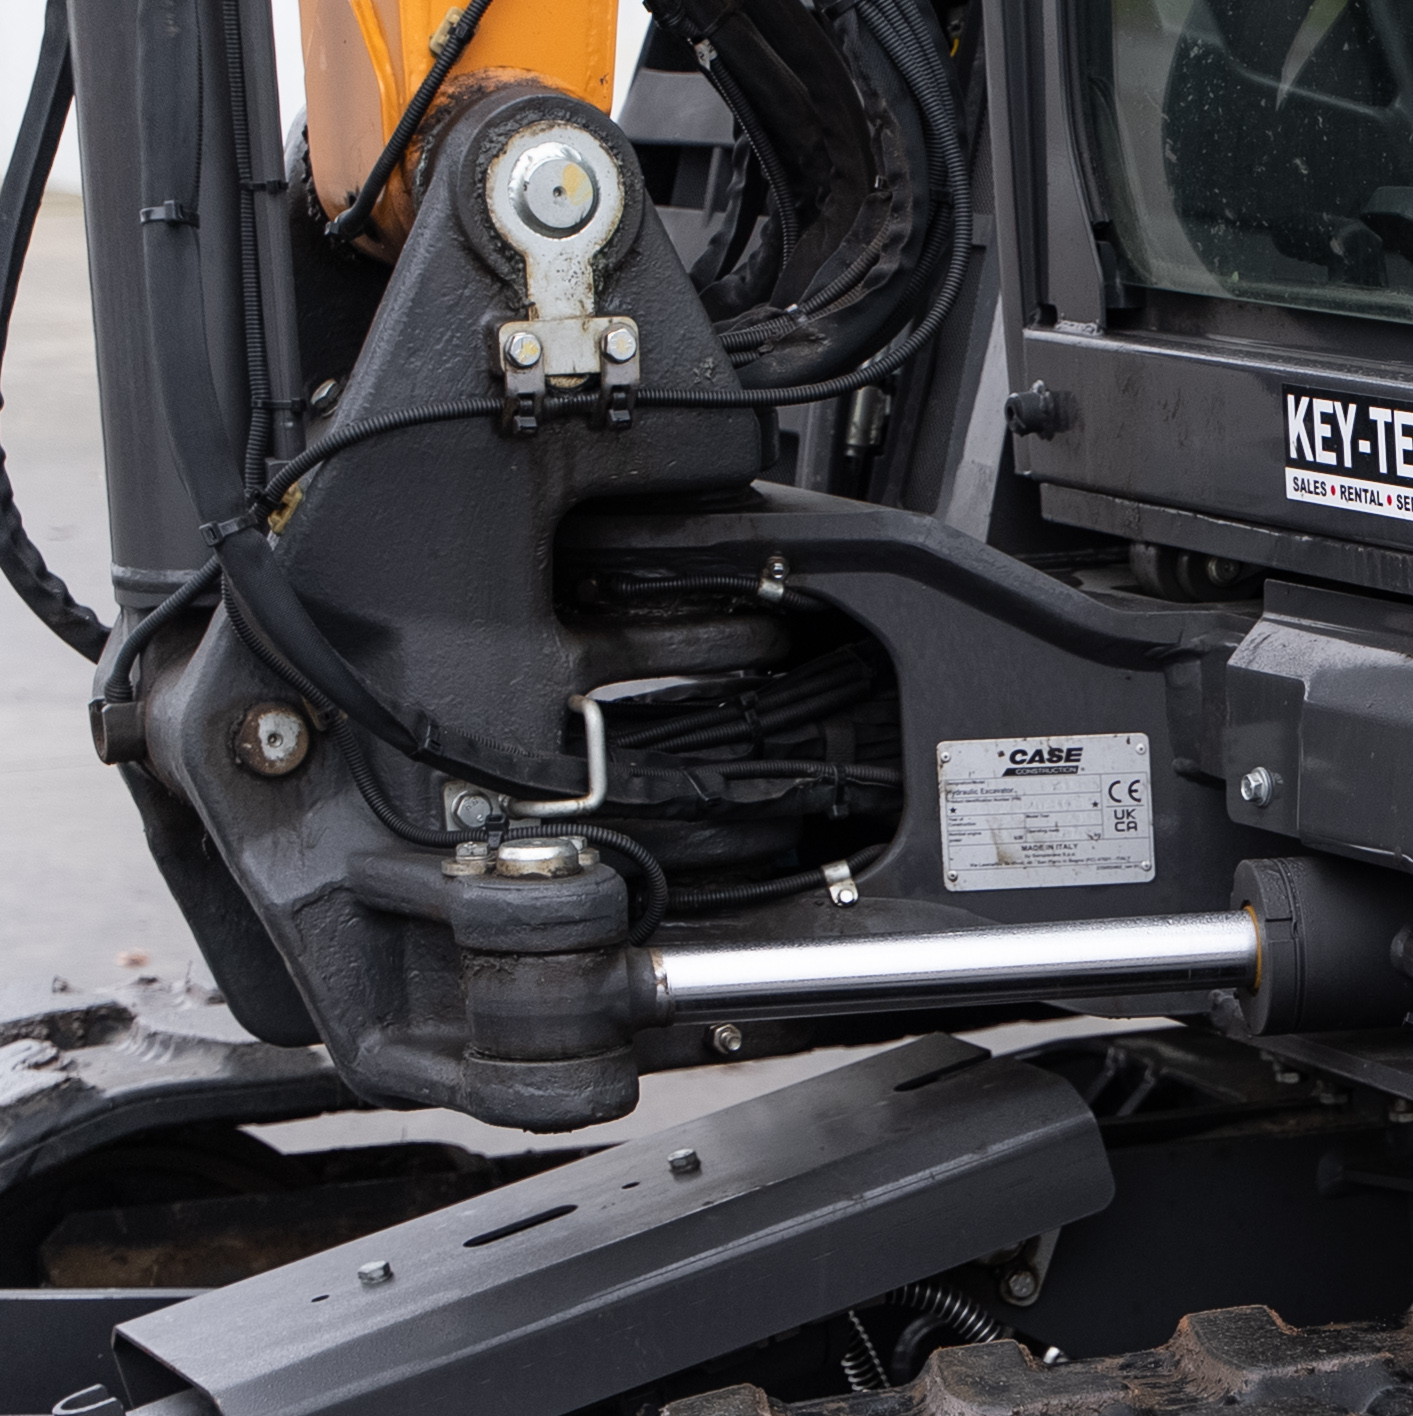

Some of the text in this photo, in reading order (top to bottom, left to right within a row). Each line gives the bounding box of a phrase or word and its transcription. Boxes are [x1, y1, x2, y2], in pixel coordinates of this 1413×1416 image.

[1292, 476, 1327, 497] SALES
[1339, 485, 1384, 507] RENTAL
[1009, 747, 1083, 765] CASE
[1015, 766, 1077, 775] CONSTRUCTION
[1108, 779, 1142, 803] CE
[1114, 808, 1136, 820] UK
[1114, 821, 1138, 832] CA
